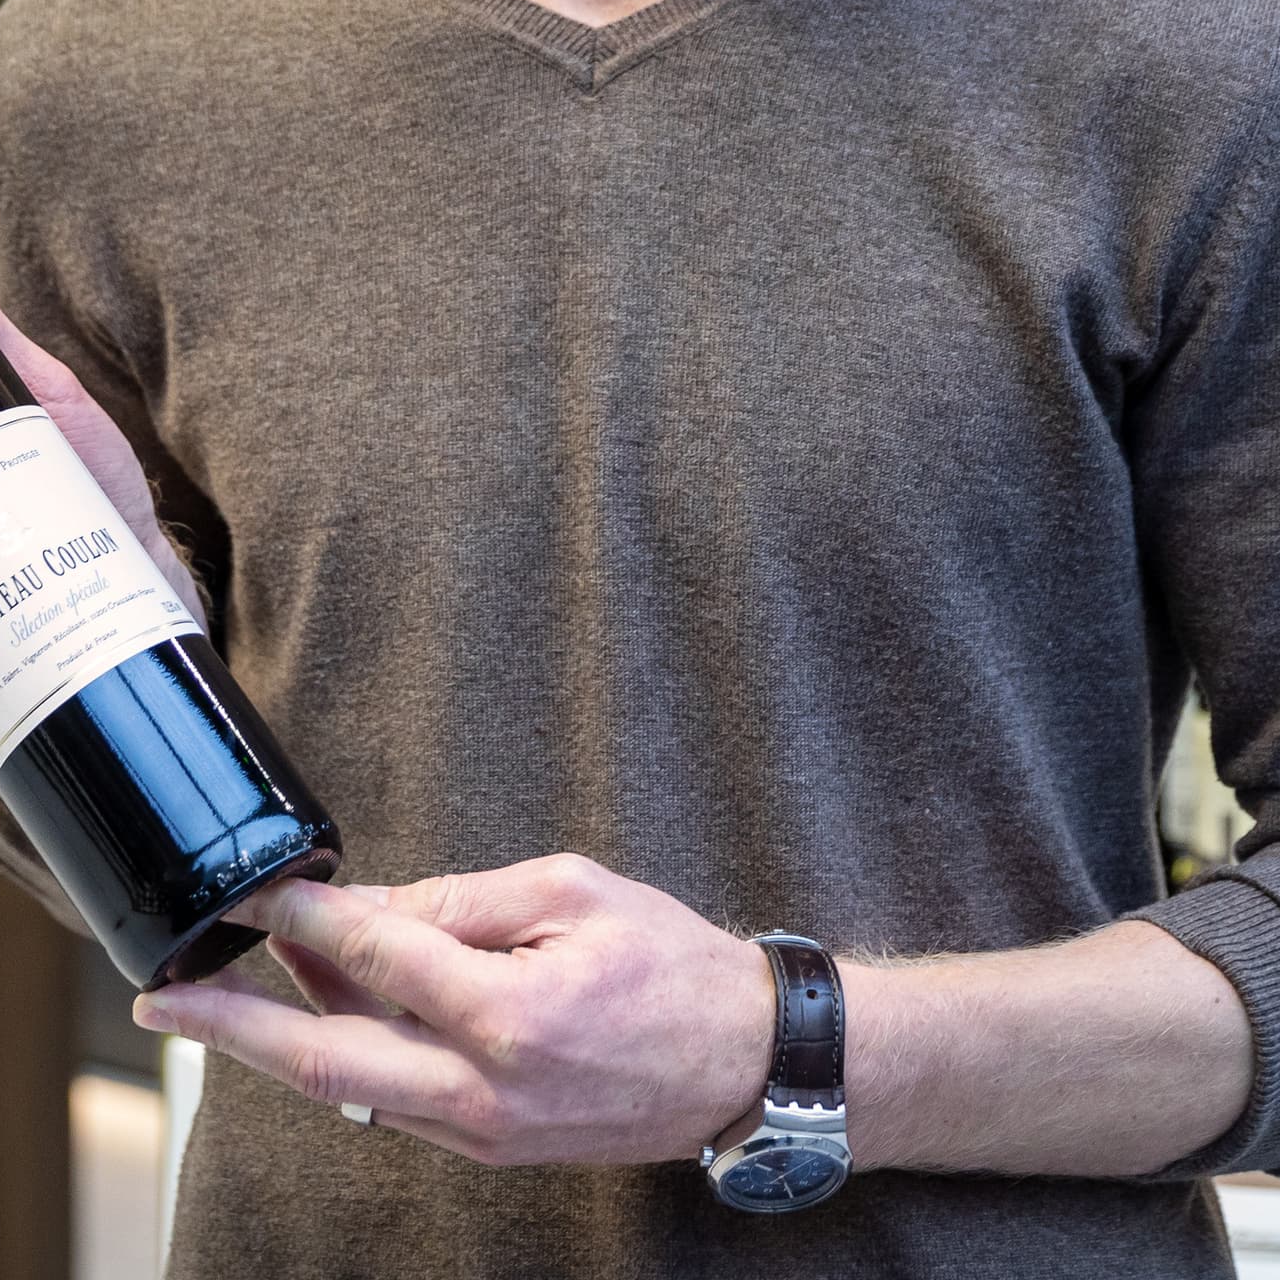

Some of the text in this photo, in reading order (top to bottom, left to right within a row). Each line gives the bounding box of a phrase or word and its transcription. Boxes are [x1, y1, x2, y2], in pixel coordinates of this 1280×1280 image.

[42, 528, 121, 577] COULON
[10, 603, 65, 649] Sélection
[21, 641, 54, 666] Vigneron
[56, 627, 119, 672] Produit de France
